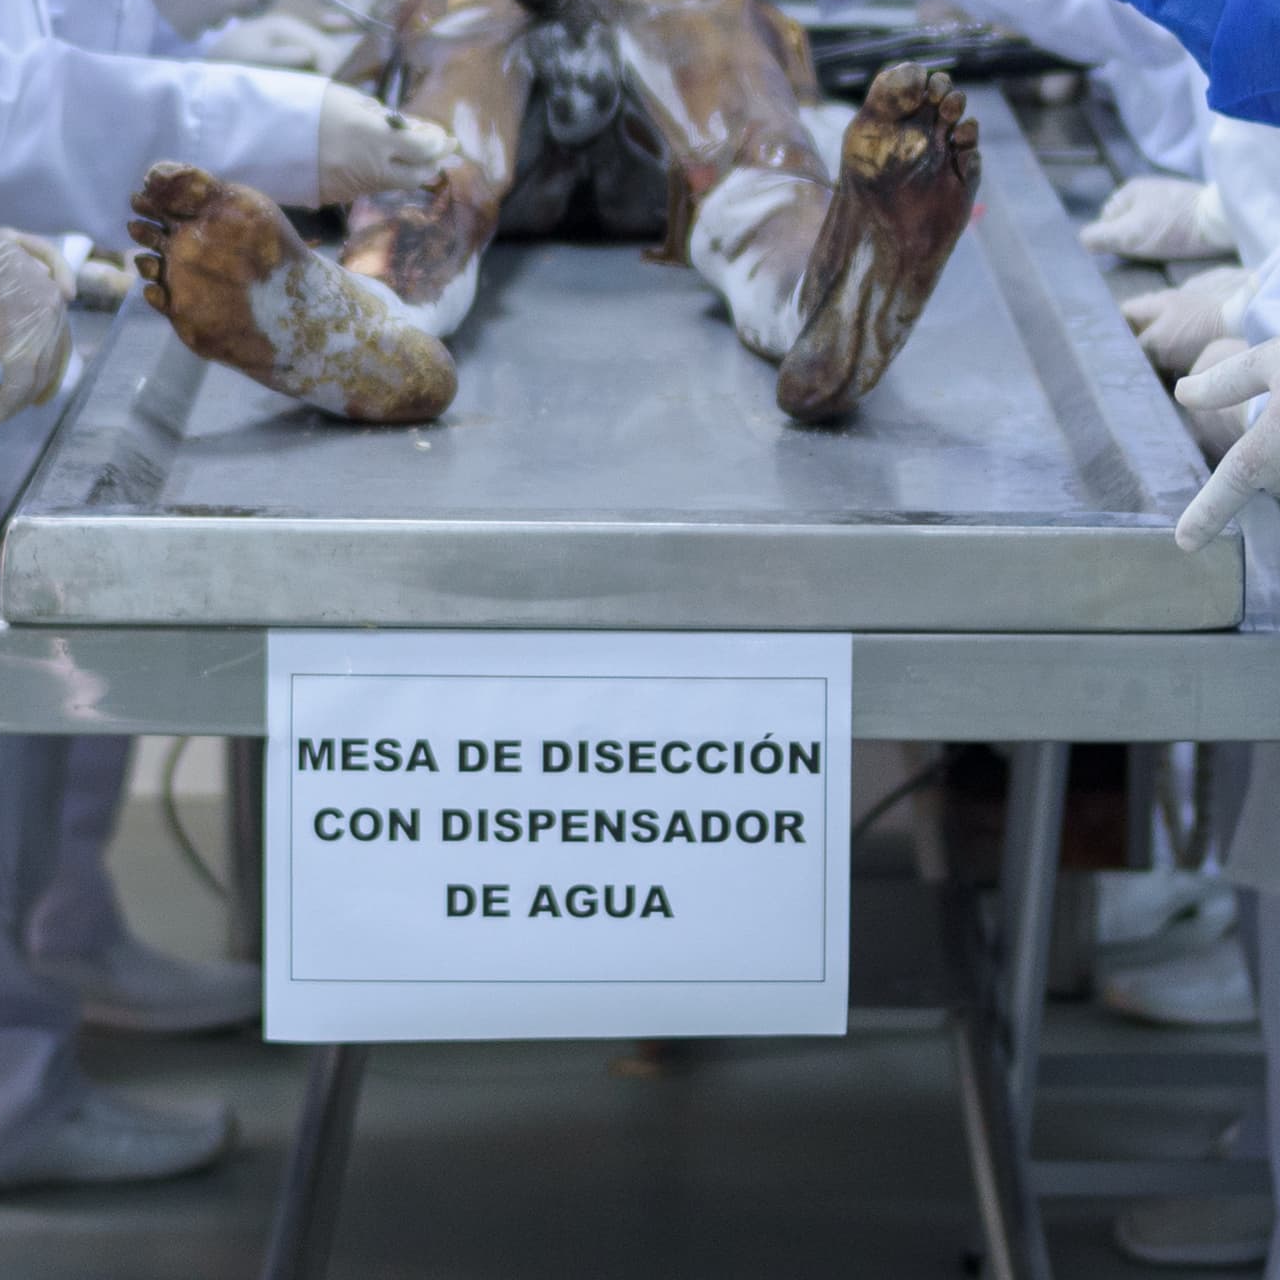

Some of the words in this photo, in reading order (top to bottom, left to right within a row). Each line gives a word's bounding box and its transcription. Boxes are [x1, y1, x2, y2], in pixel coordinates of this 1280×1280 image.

[297, 738, 439, 773] MESA
[457, 739, 522, 773] DE
[542, 733, 821, 775] DISECCIÓN
[313, 807, 420, 842] CON
[441, 809, 806, 845] DISPENSADOR
[446, 885, 510, 918] DE
[528, 884, 674, 919] AGUA
